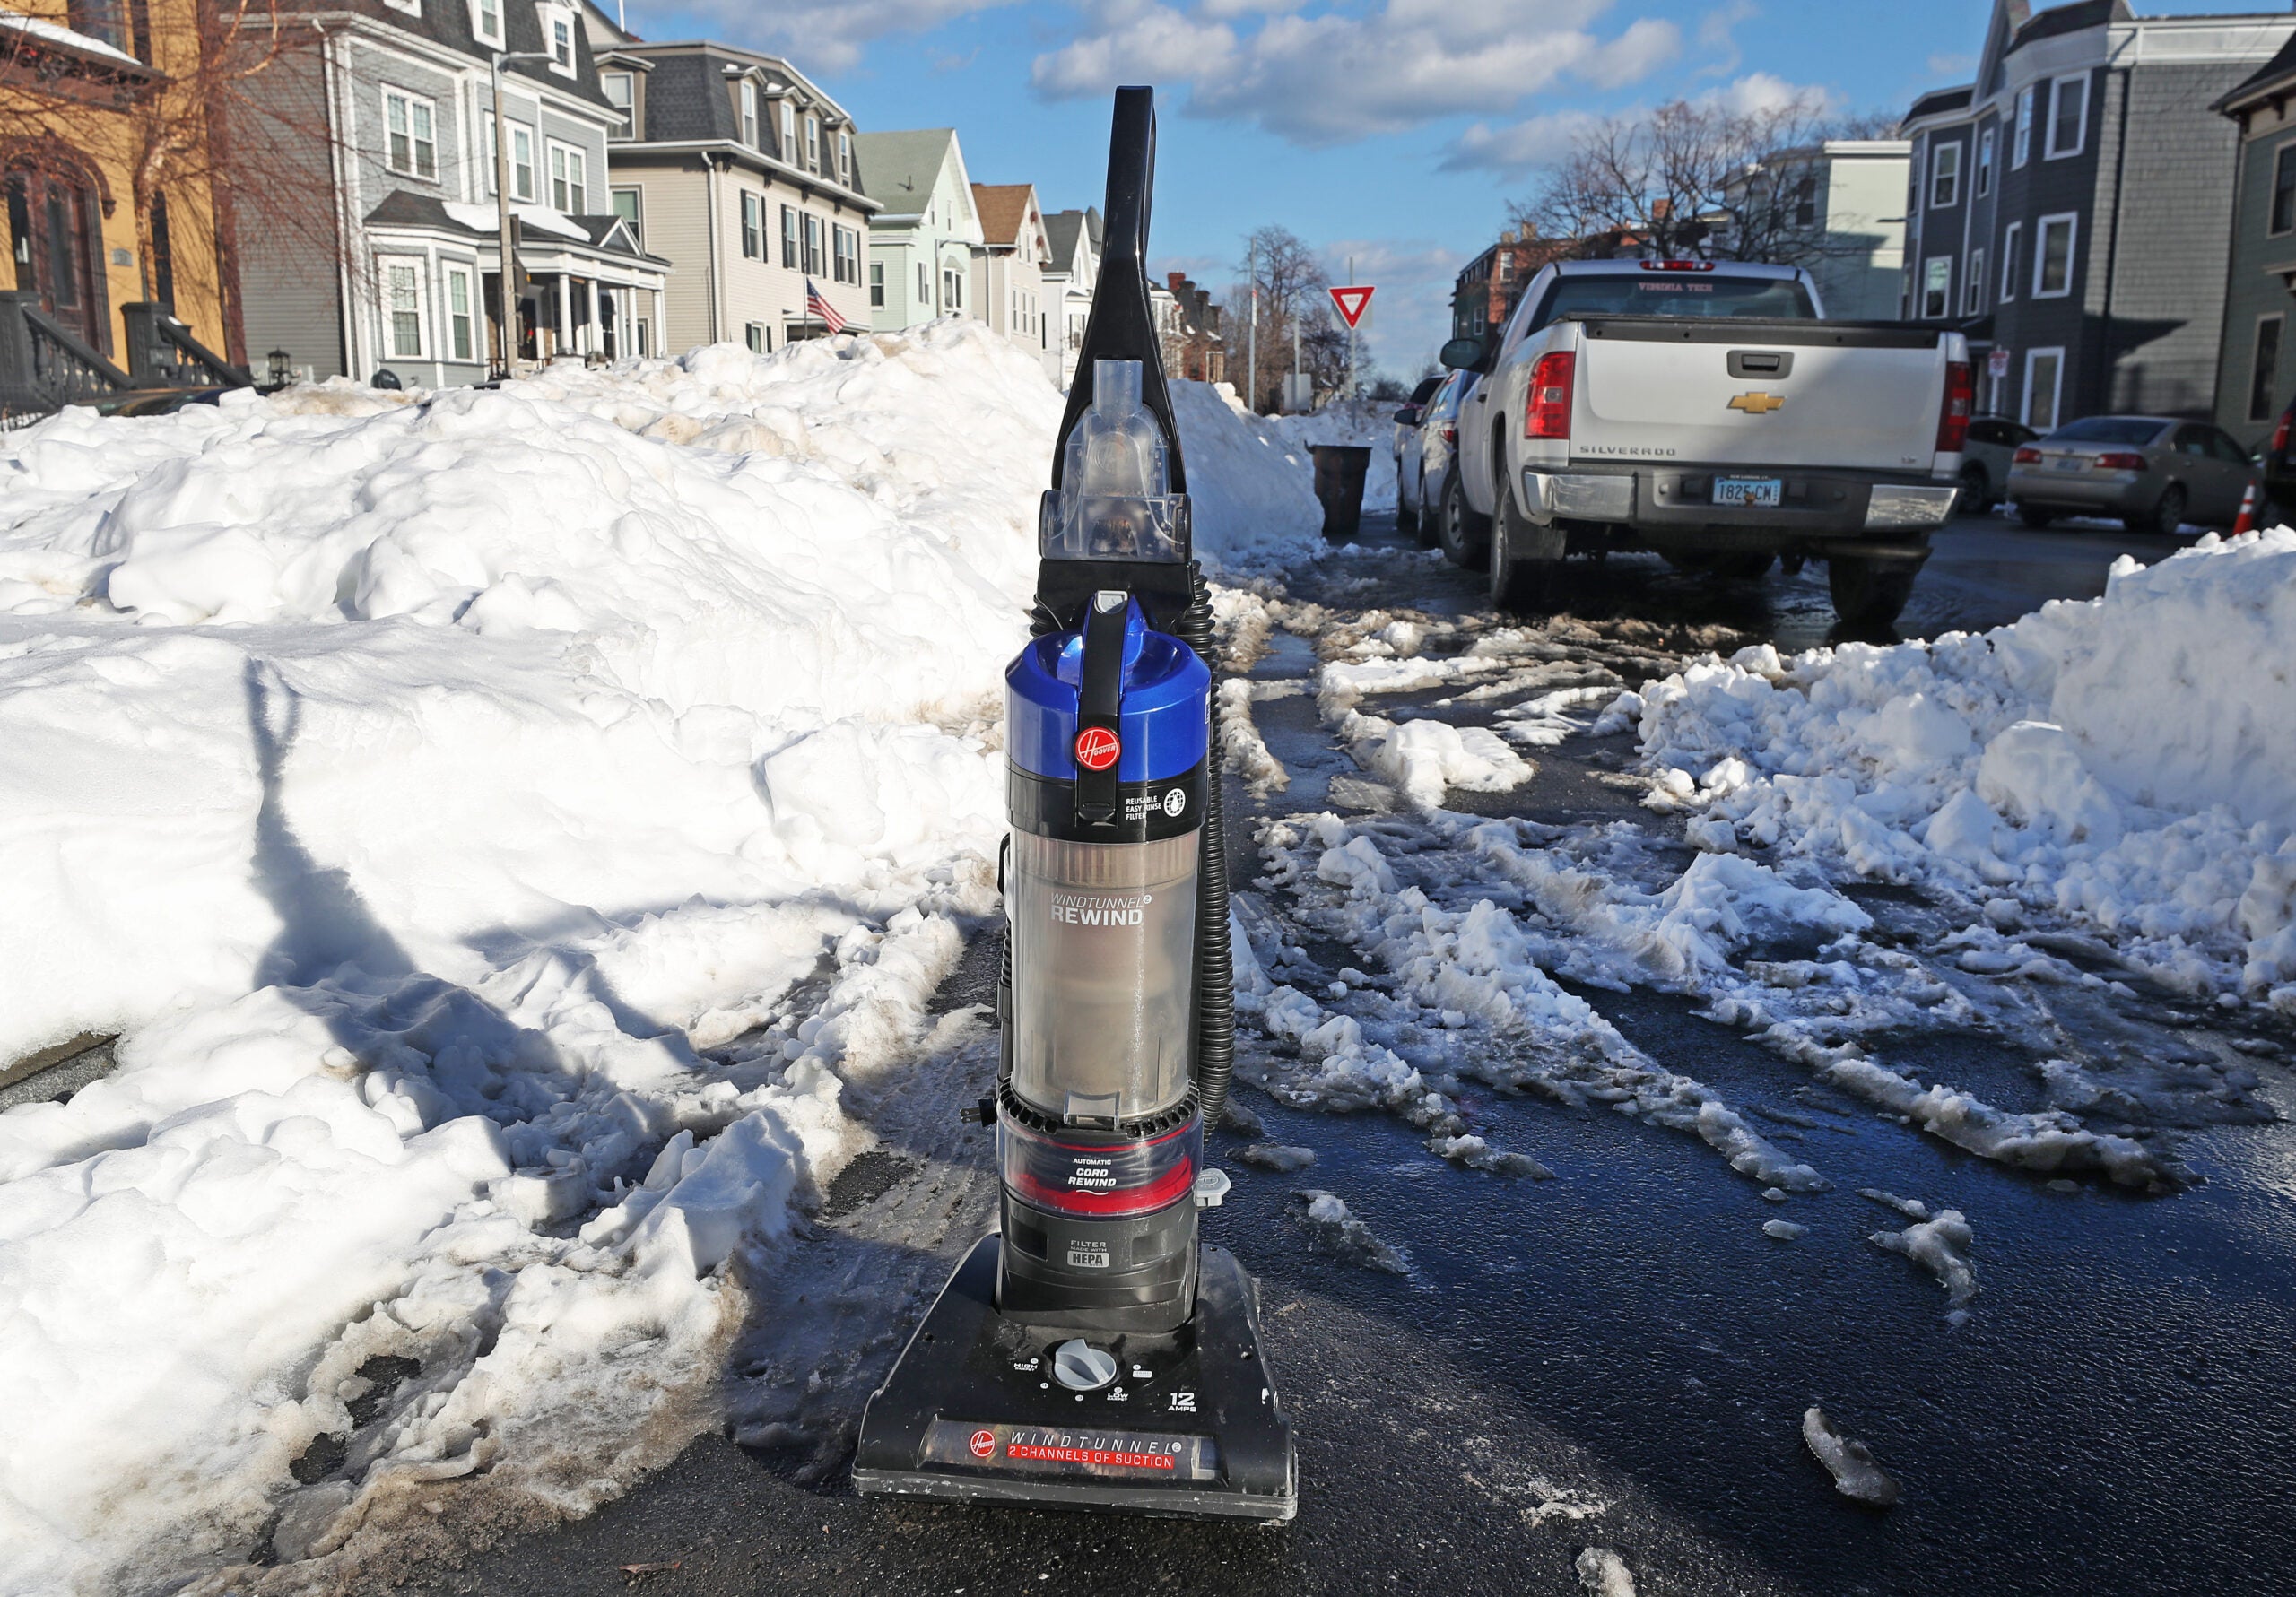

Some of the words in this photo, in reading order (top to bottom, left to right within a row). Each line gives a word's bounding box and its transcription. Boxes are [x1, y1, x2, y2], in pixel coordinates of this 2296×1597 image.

[1579, 446, 1675, 456] SILVERADO
[1126, 795, 1158, 805] REUSABLE
[1144, 803, 1161, 812] RINSE
[1126, 812, 1146, 820] FILTER
[1051, 905, 1144, 925] REWIND
[1074, 1158, 1111, 1166] AUTOMATIC
[1076, 1167, 1109, 1177] CORD
[1067, 1176, 1117, 1186] REWIND
[1070, 1239, 1107, 1247] FILTER
[1073, 1253, 1103, 1264] HEPA
[1170, 1392, 1196, 1406] 12
[1009, 1445, 1016, 1455] 2
[1020, 1446, 1089, 1462] CHANNELS
[1094, 1452, 1110, 1462] OF
[1115, 1454, 1172, 1468] SUCTION
